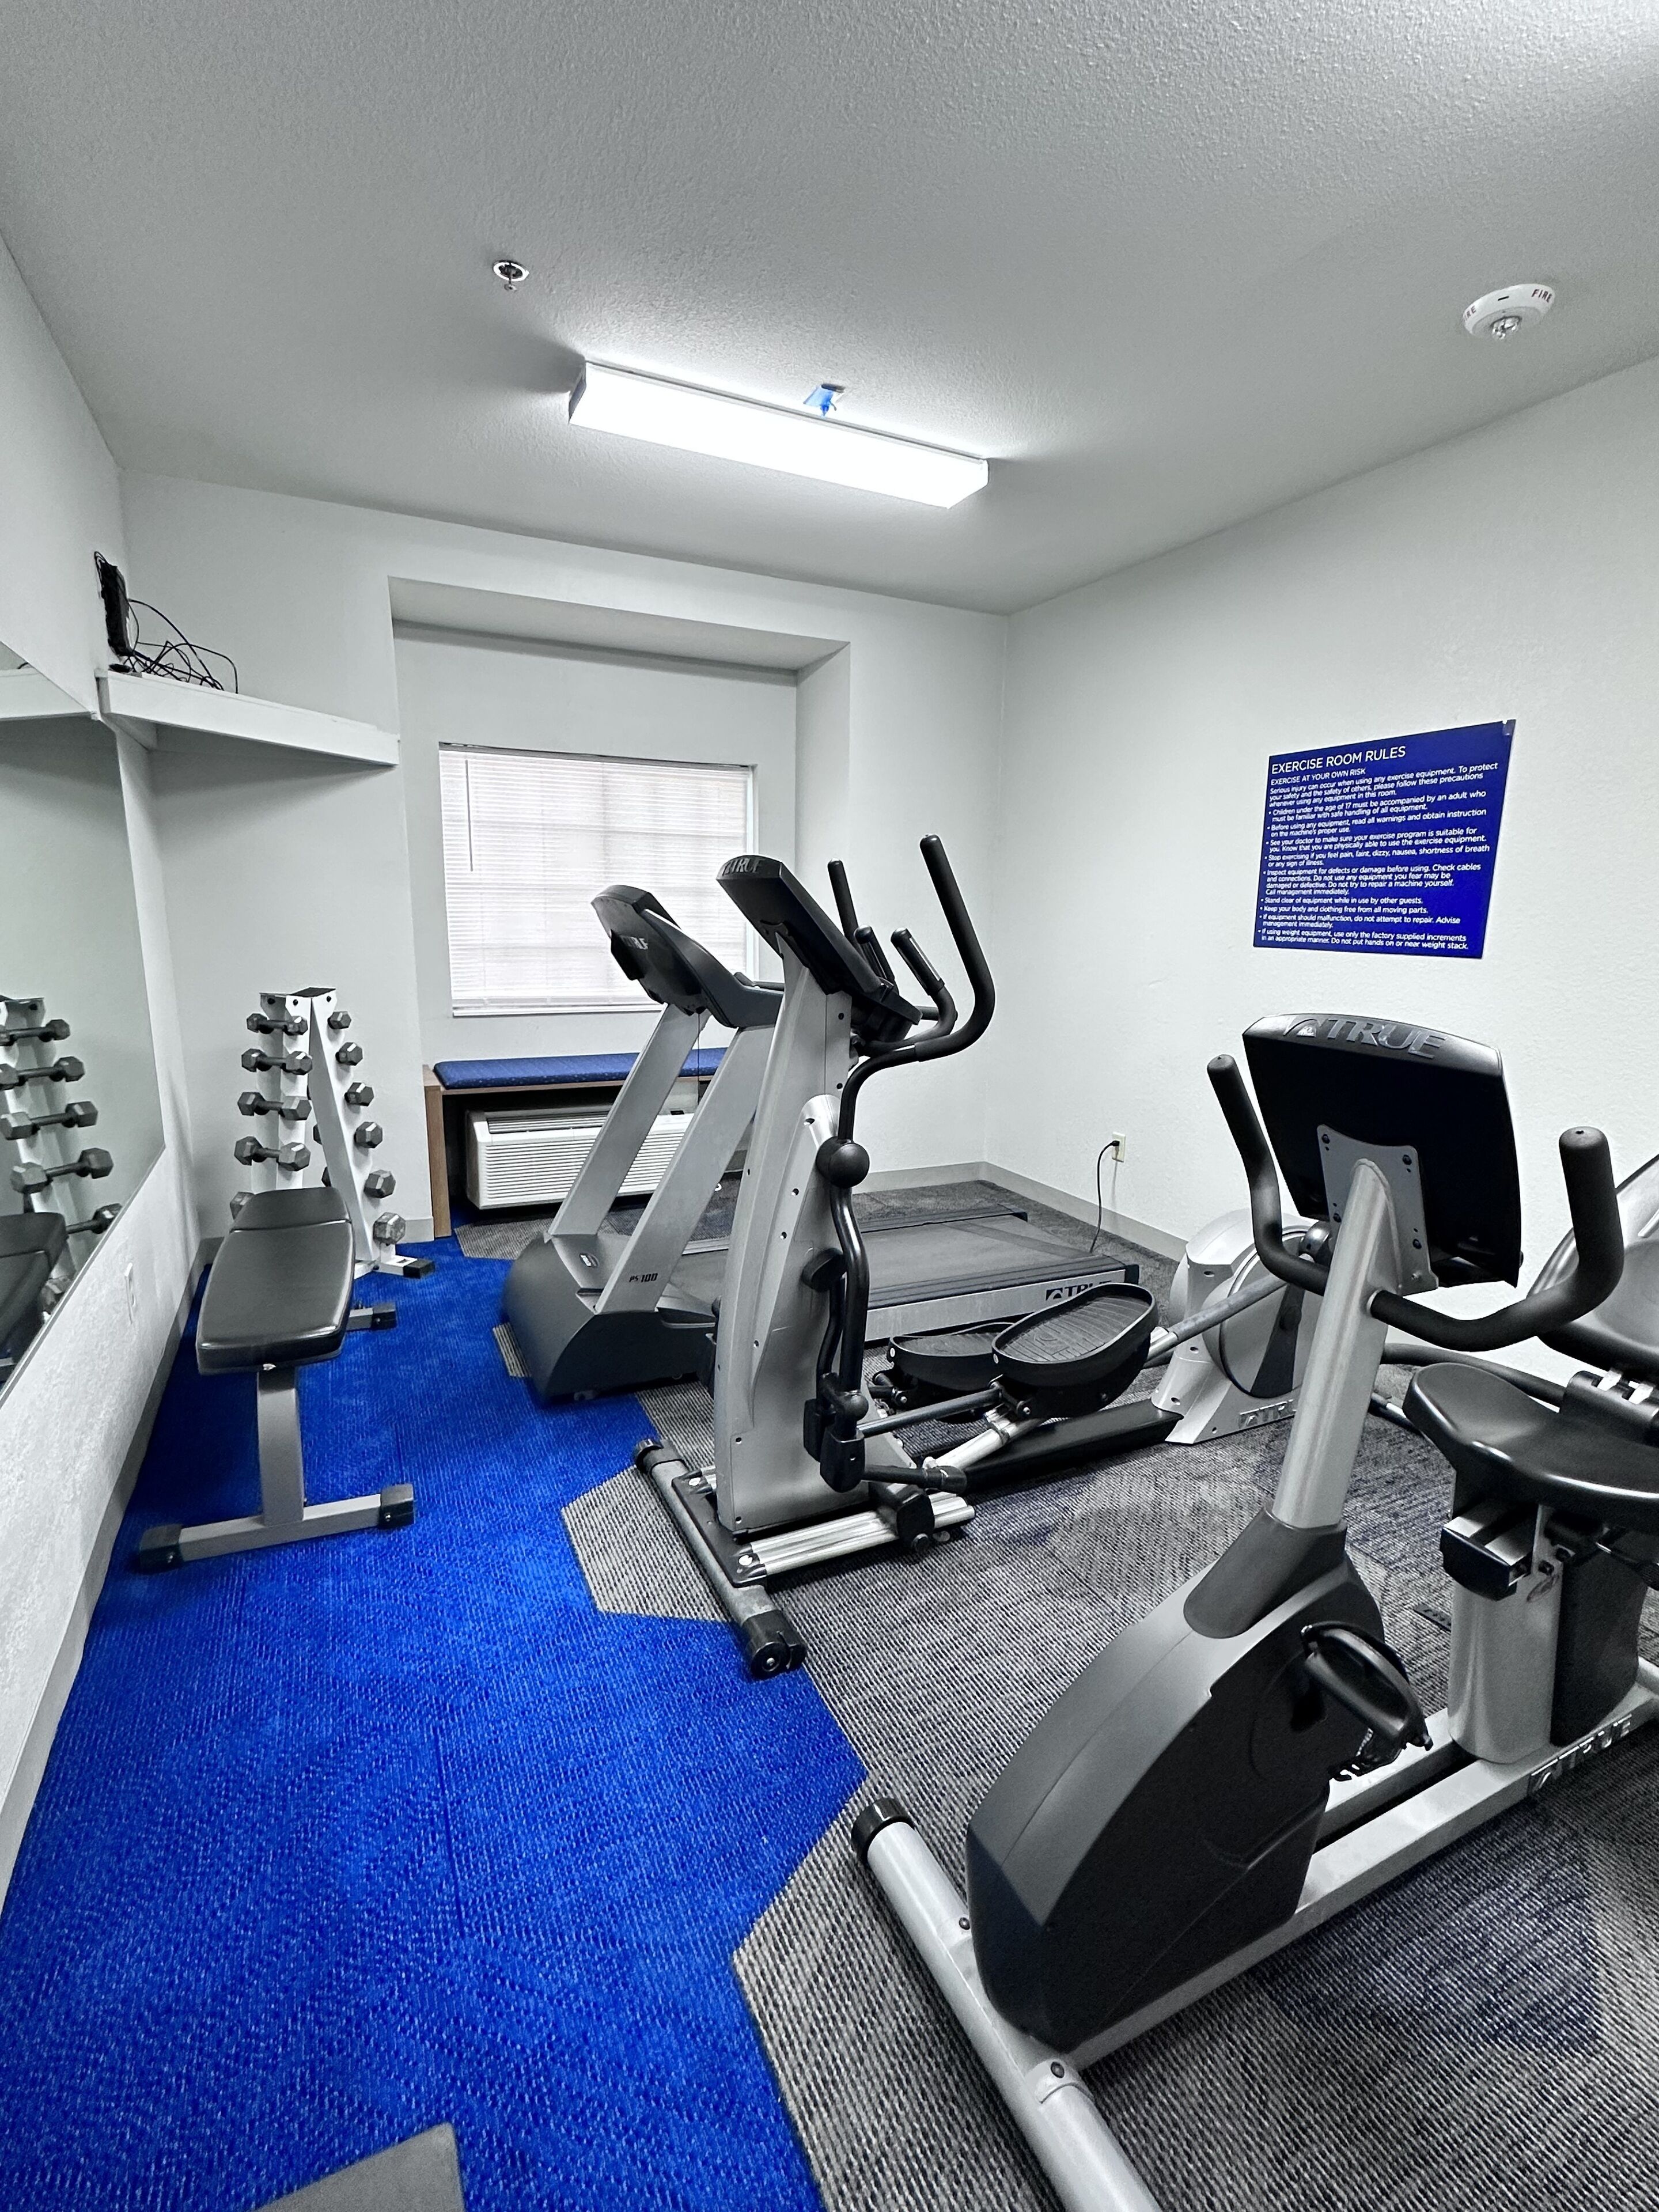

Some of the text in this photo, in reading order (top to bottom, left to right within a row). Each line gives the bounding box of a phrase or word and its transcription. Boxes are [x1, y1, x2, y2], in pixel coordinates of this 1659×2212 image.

[1531, 289, 1552, 302] FIRE
[1271, 745, 1407, 774] EXERCISE ROOM RULES
[1270, 775, 1301, 786] EXERCISE
[1310, 771, 1330, 781] YOUR
[1330, 769, 1349, 778] OWN
[1349, 767, 1366, 776] RISK
[1386, 773, 1414, 781] exercise
[1468, 762, 1498, 773] protect
[1373, 783, 1395, 791] please
[1438, 773, 1483, 785] precautions
[1378, 796, 1425, 806] accompanied
[1426, 795, 1436, 803] by
[1446, 809, 1487, 818] instruction
[1396, 832, 1427, 840] program
[1333, 842, 1363, 850] physically
[1464, 844, 1490, 853] breath
[1371, 932, 1395, 940] factory
[1327, 1018, 1448, 1059] TRUE
